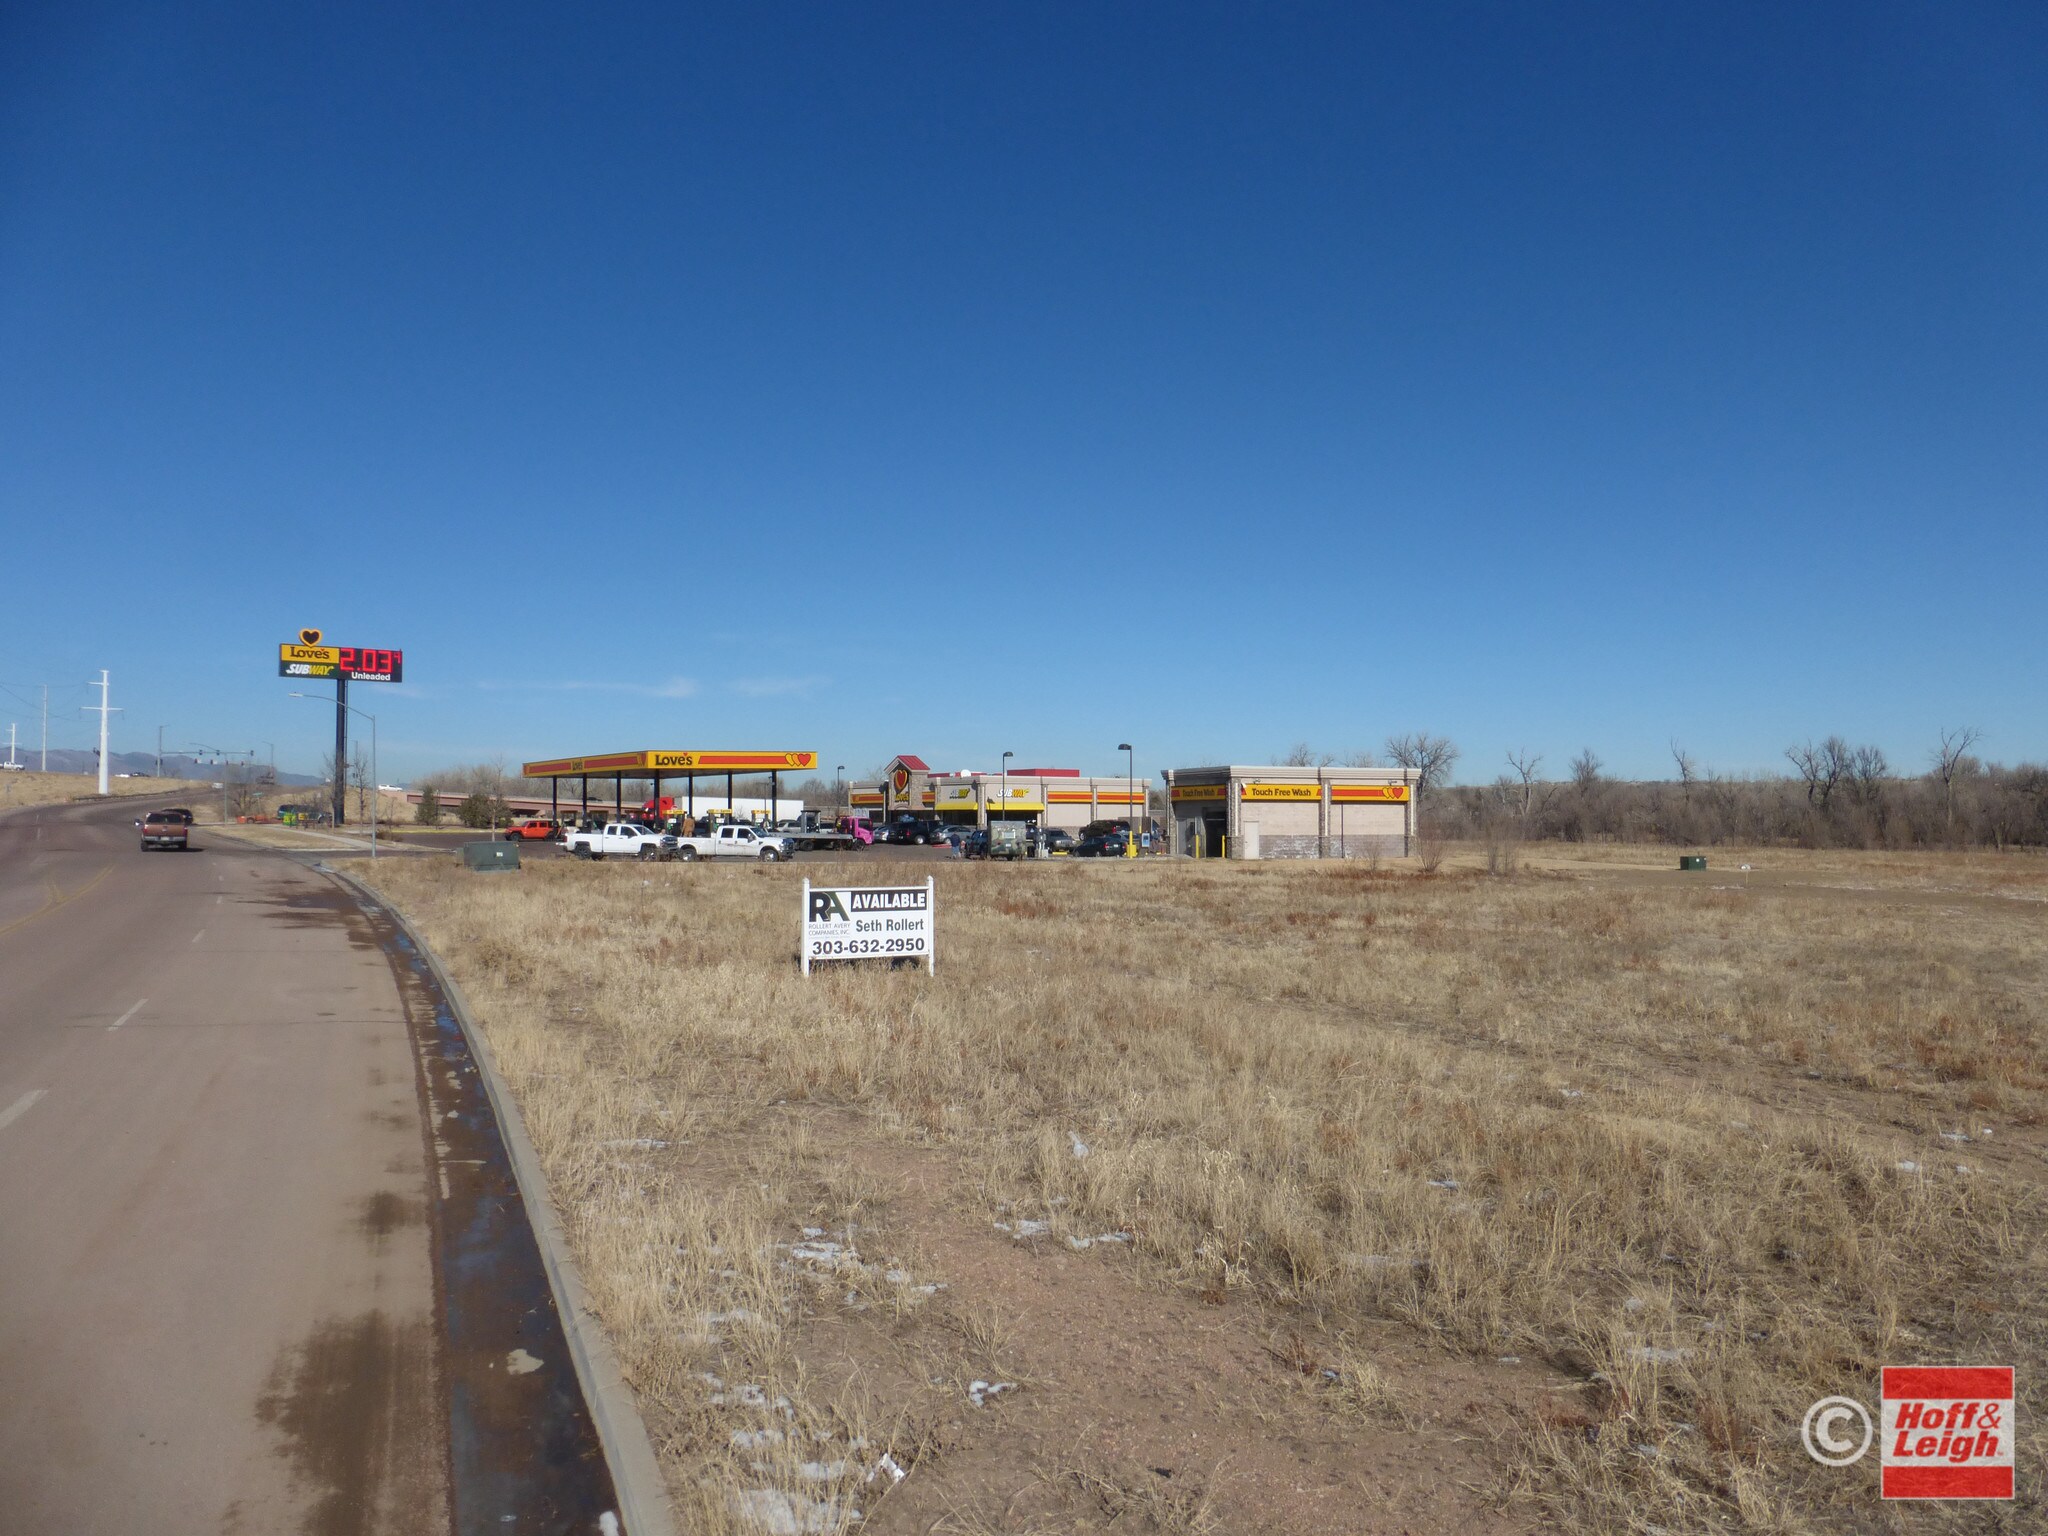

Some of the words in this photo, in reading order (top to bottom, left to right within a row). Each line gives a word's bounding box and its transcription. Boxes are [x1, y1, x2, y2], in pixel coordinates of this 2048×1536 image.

[290, 647, 330, 660] Love's
[286, 664, 334, 676] SUBWAY
[351, 671, 391, 681] Unleaded
[655, 752, 693, 766] Love's
[997, 788, 1030, 799] SUBWAY
[1252, 788, 1273, 797] Touch
[1275, 788, 1291, 797] Free
[1293, 788, 1312, 797] Wash
[852, 893, 925, 909] AVAILABLE
[856, 919, 882, 932] Seth
[886, 918, 924, 931] Rollert
[812, 938, 925, 955] 303-632-2950
